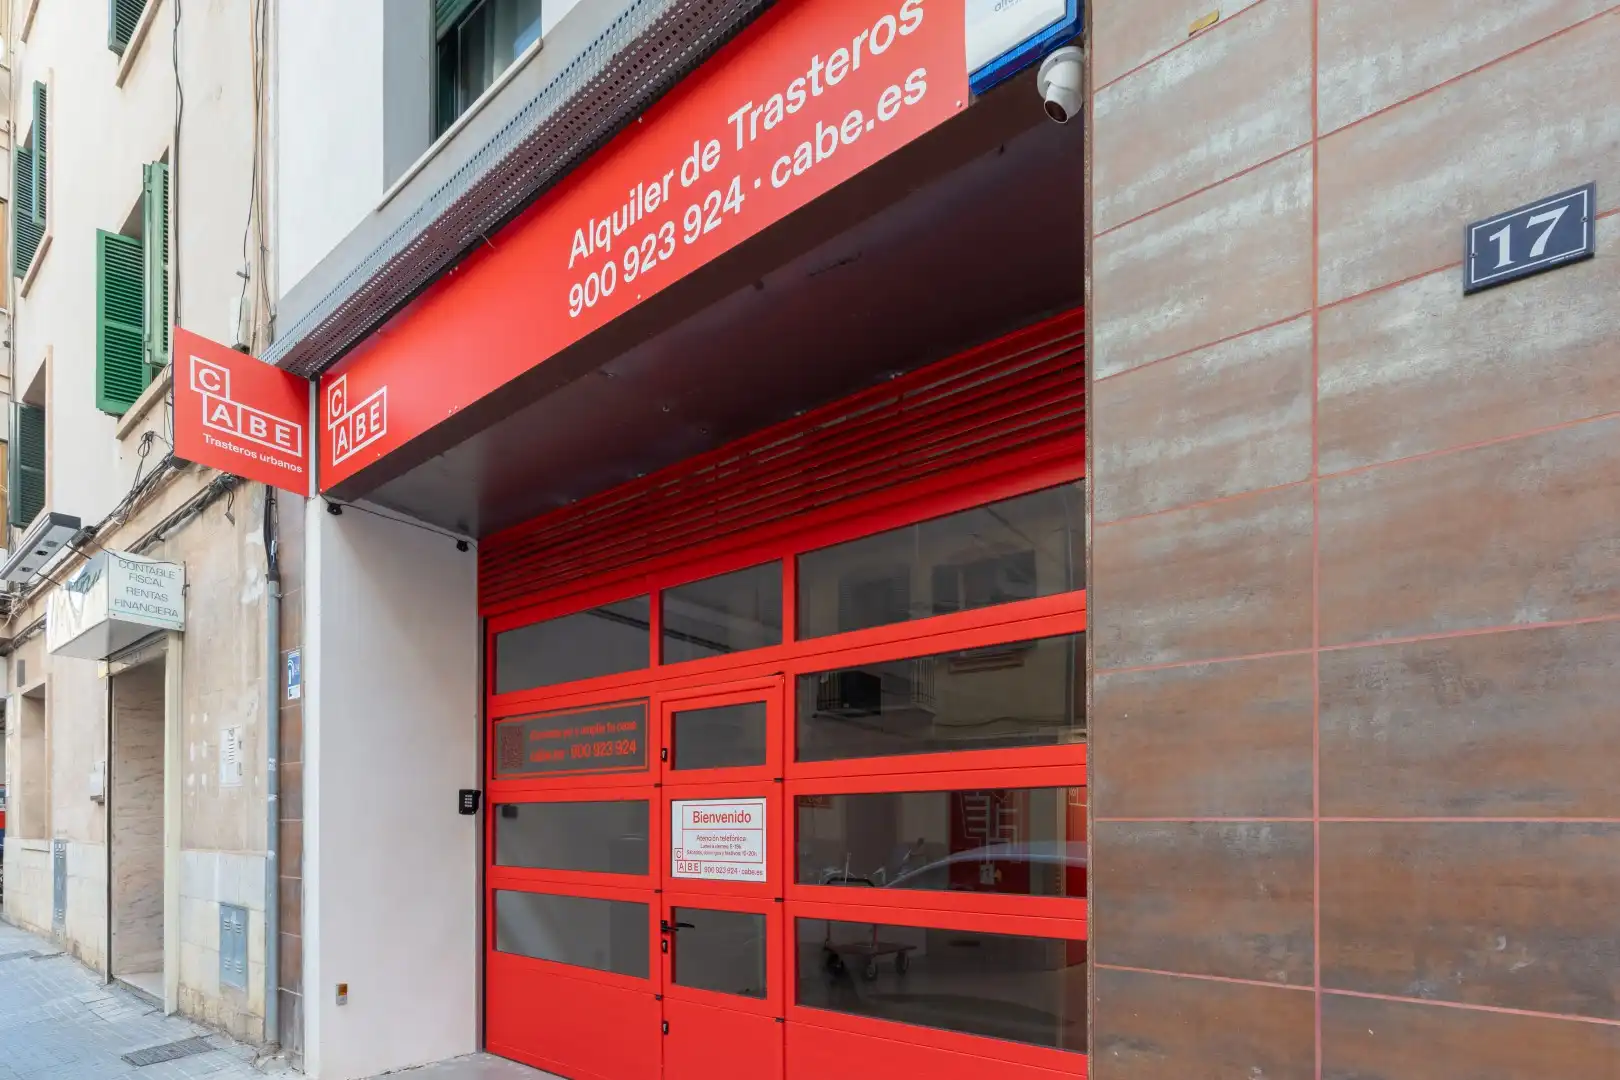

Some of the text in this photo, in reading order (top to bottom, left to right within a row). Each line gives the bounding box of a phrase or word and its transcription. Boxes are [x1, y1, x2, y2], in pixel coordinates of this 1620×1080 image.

[568, 0, 924, 270] Alquiler de Trasteros
[568, 260, 617, 318] 900
[623, 220, 676, 283] 923
[683, 174, 745, 245] 924
[770, 67, 927, 189] cabe.es
[1488, 204, 1570, 270] 17
[203, 433, 303, 473] Trasteros urbanos
[118, 559, 176, 580] CONTABLE
[128, 572, 165, 588] FISCAL
[126, 586, 169, 603] RENTAS
[114, 598, 179, 618] FINANCIERA
[592, 740, 614, 757] 923
[615, 738, 637, 756] 924
[692, 810, 751, 824] Bienvenido
[696, 834, 719, 842] Atención
[703, 865, 715, 874] 900
[715, 866, 726, 874] 923
[726, 867, 738, 875] 924
